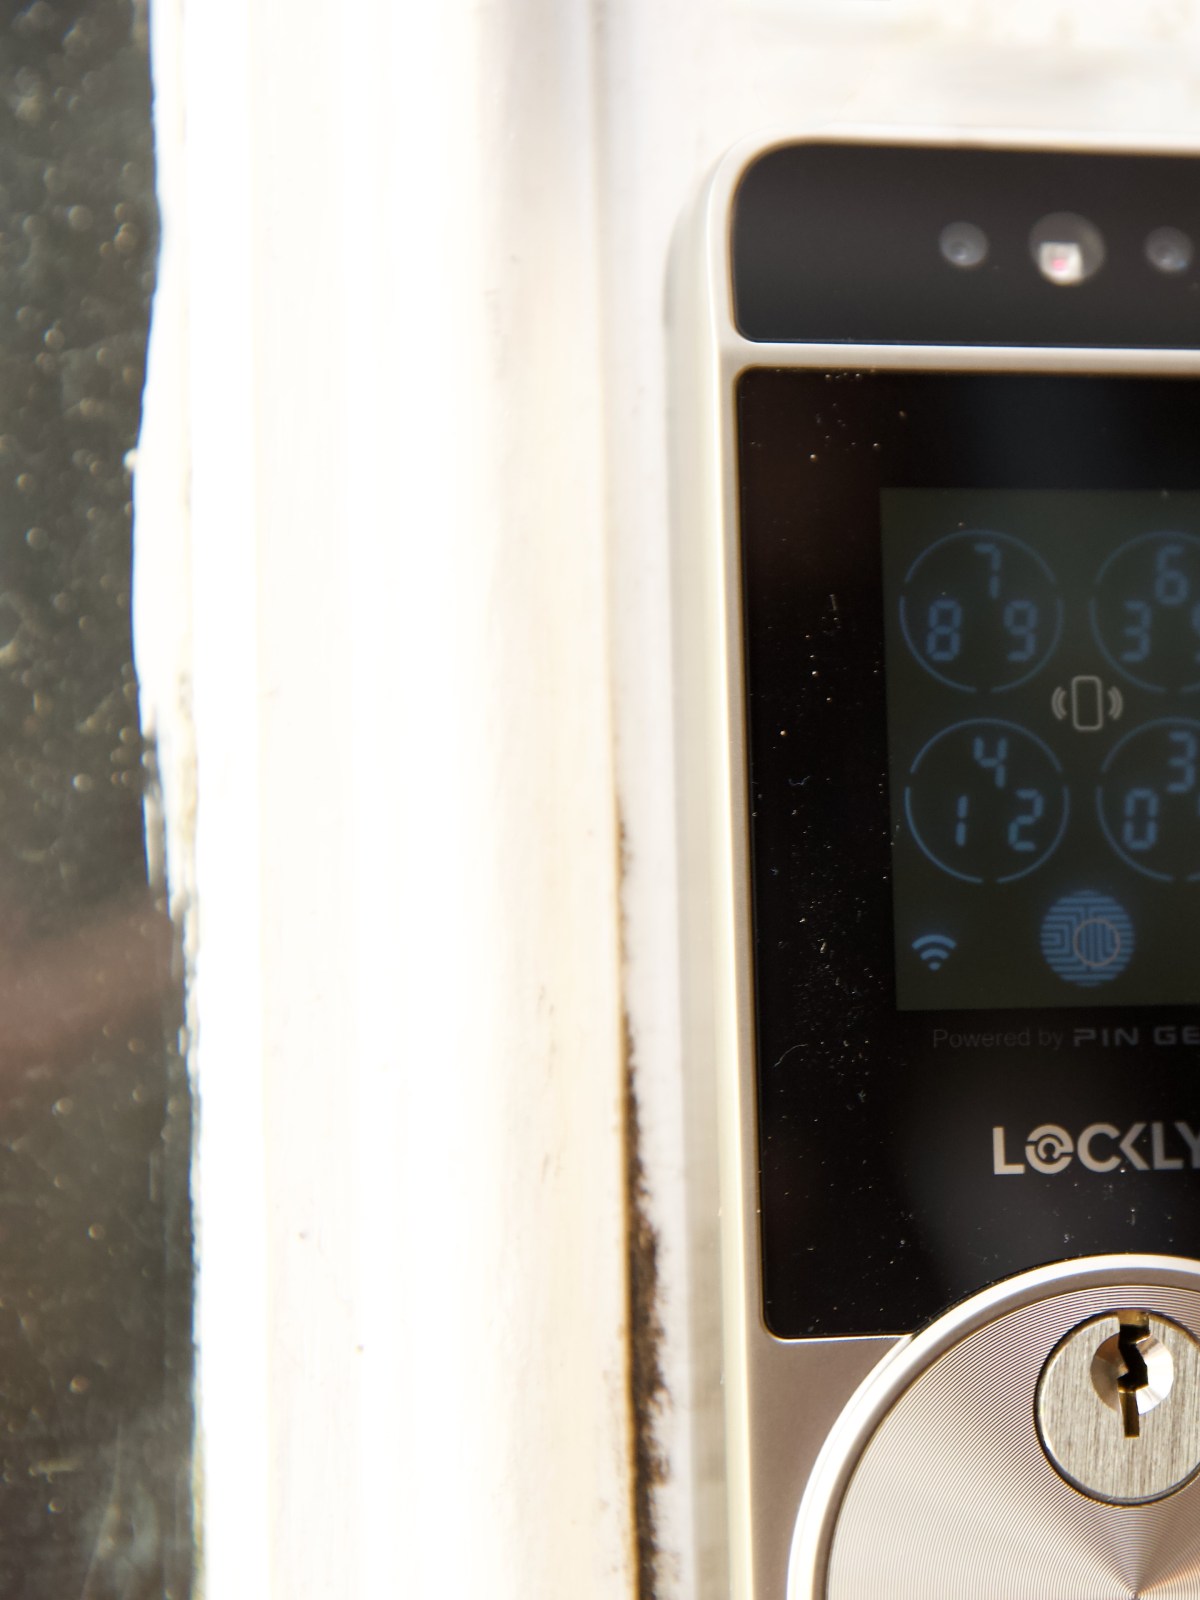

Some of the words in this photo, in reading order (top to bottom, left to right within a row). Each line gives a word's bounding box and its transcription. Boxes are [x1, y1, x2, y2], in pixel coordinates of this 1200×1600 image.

[973, 543, 1001, 599] 7
[1154, 544, 1189, 605] 6
[926, 600, 962, 661] 8
[1004, 600, 1038, 661] 9
[1121, 600, 1151, 662] 3
[973, 736, 1008, 788] 4
[1166, 731, 1197, 793] 3
[955, 795, 968, 846] 1
[1008, 788, 1044, 851] 2
[1124, 788, 1158, 850] 0
[933, 1028, 1031, 1049] Powered
[1038, 1027, 1064, 1050] by
[1072, 1027, 1139, 1047] PIN
